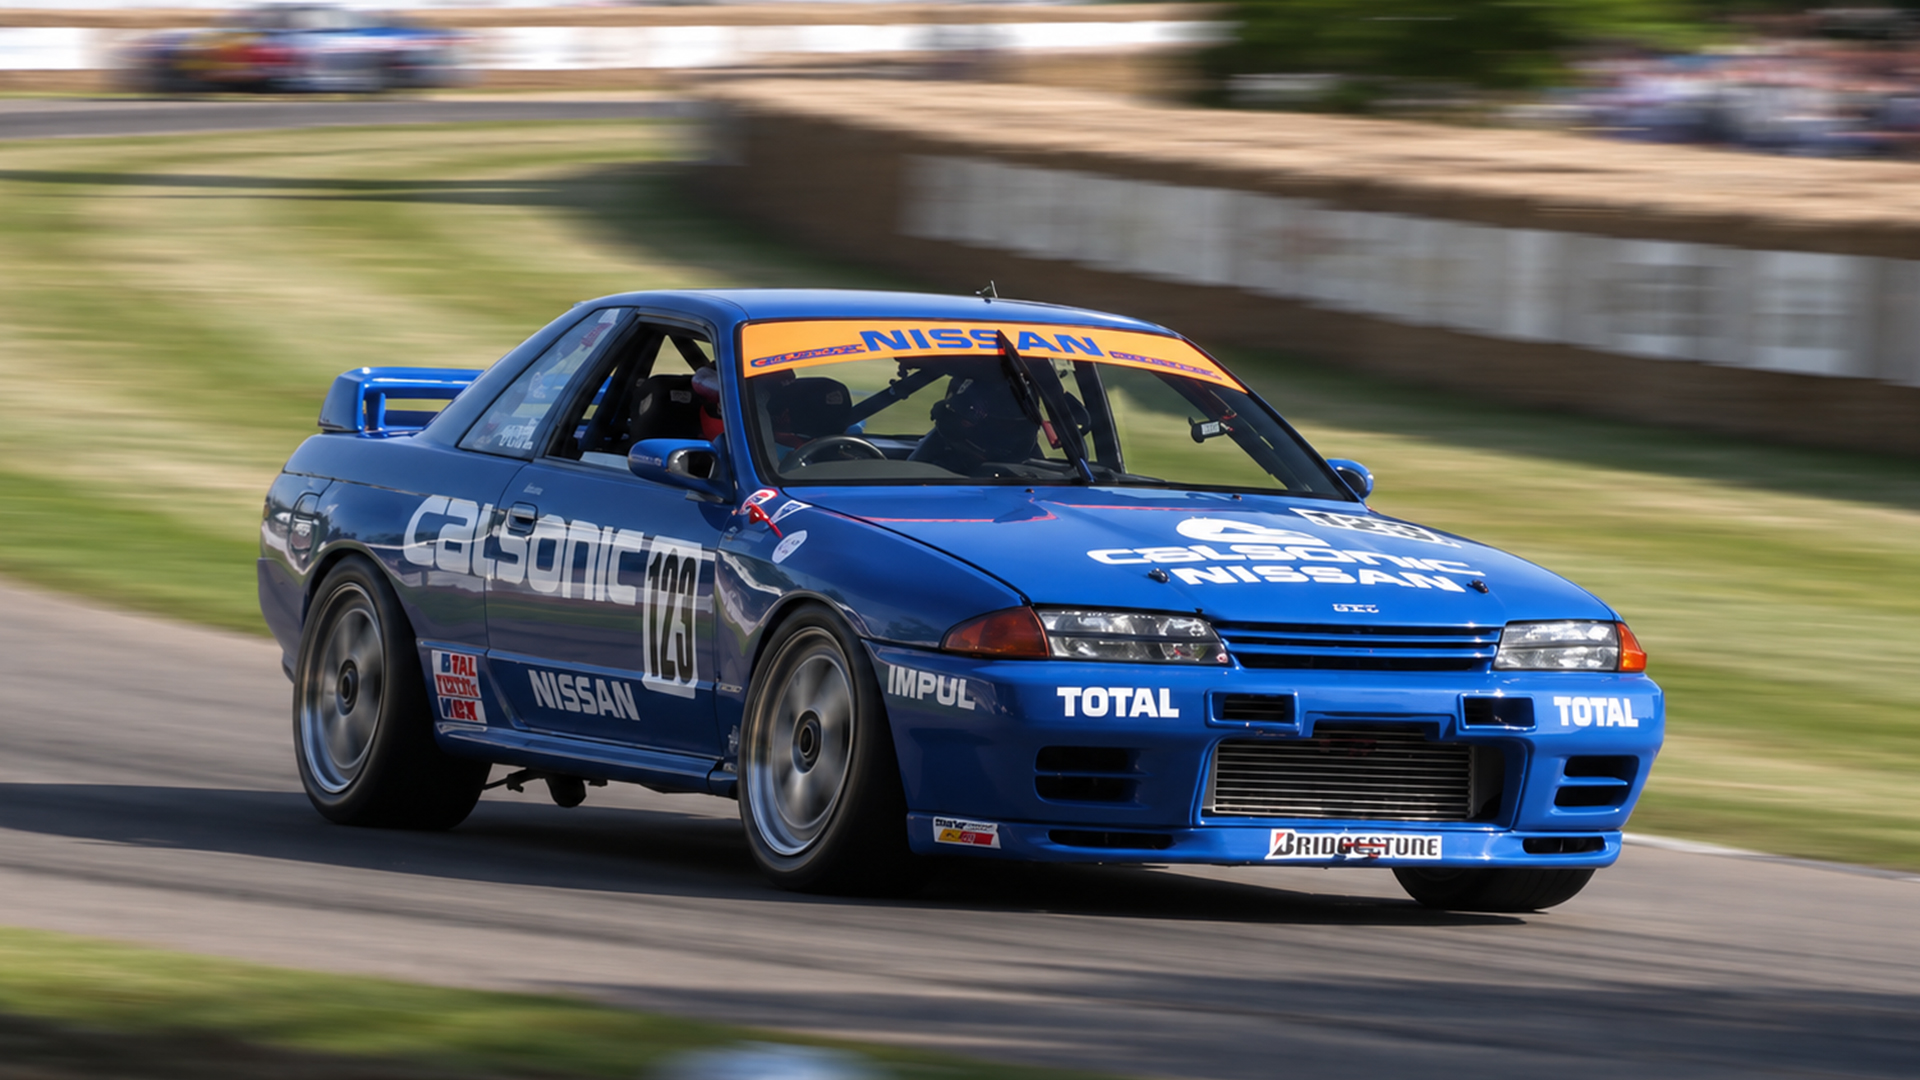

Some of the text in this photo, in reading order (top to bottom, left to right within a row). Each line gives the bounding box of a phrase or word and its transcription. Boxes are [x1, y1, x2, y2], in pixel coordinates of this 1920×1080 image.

[859, 328, 1105, 357] NISSAN
[1170, 565, 1467, 592] NISSAN
[648, 547, 697, 684] 123
[528, 669, 641, 721] NISSAN
[887, 664, 976, 710] IMPUL
[1057, 686, 1179, 718] TOTAL
[1553, 696, 1639, 727] TOTAL
